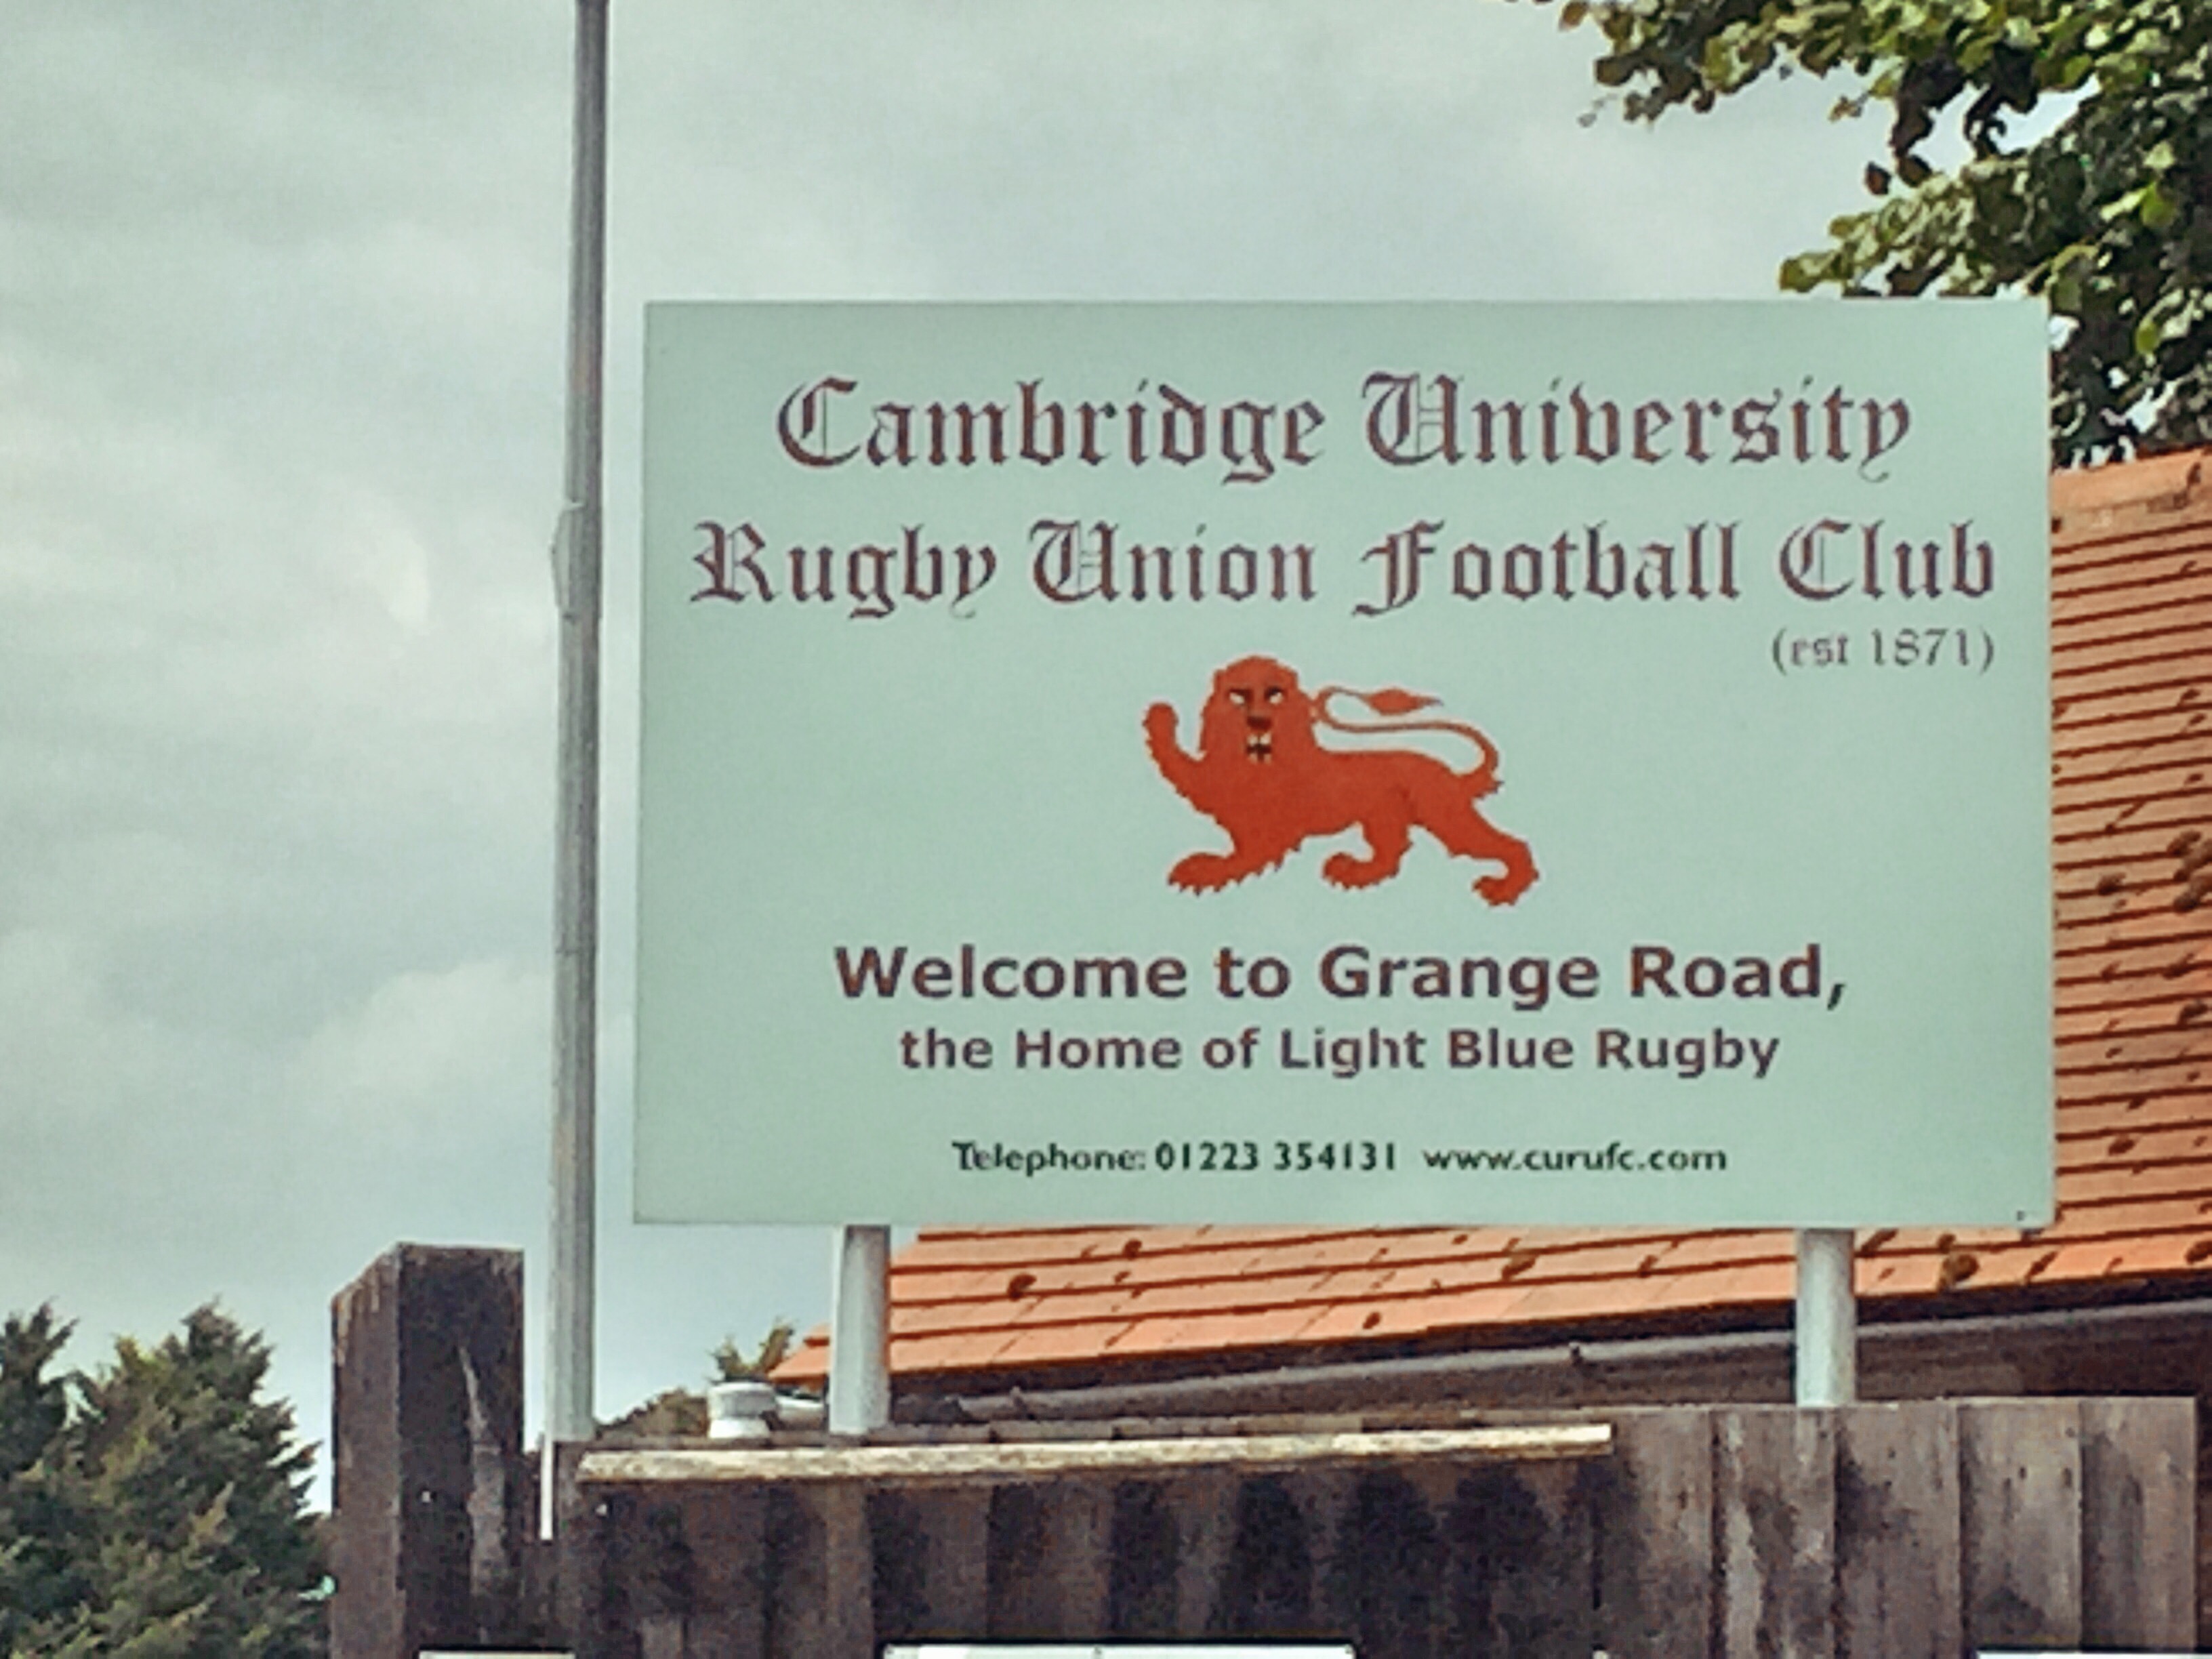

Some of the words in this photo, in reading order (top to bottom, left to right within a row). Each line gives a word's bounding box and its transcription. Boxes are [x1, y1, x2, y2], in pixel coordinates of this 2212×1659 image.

[777, 376, 1326, 484] Cambridge
[1362, 372, 1910, 483] University
[690, 521, 997, 619] Rugby
[1029, 519, 1316, 603] Union
[1352, 520, 1740, 617] Football
[1779, 518, 1994, 602] Club
[1771, 630, 1849, 673] (est
[1871, 629, 1994, 672] 1871)
[834, 943, 1187, 1000] Welcome
[1214, 947, 1292, 1000] to
[1319, 945, 1600, 1012] Grange
[1630, 943, 1846, 1011] Road,
[900, 1027, 993, 1069] the
[1016, 1029, 1182, 1069] Home
[1202, 1027, 1261, 1069] of
[1281, 1027, 1427, 1080] Light
[1448, 1027, 1574, 1069] Blue
[1597, 1027, 1780, 1080] Rugby
[951, 1141, 1146, 1178] Telephone:
[1155, 1141, 1259, 1171] 01223
[1274, 1141, 1395, 1172] 354131
[1423, 1141, 1727, 1172] www.curufc.com
